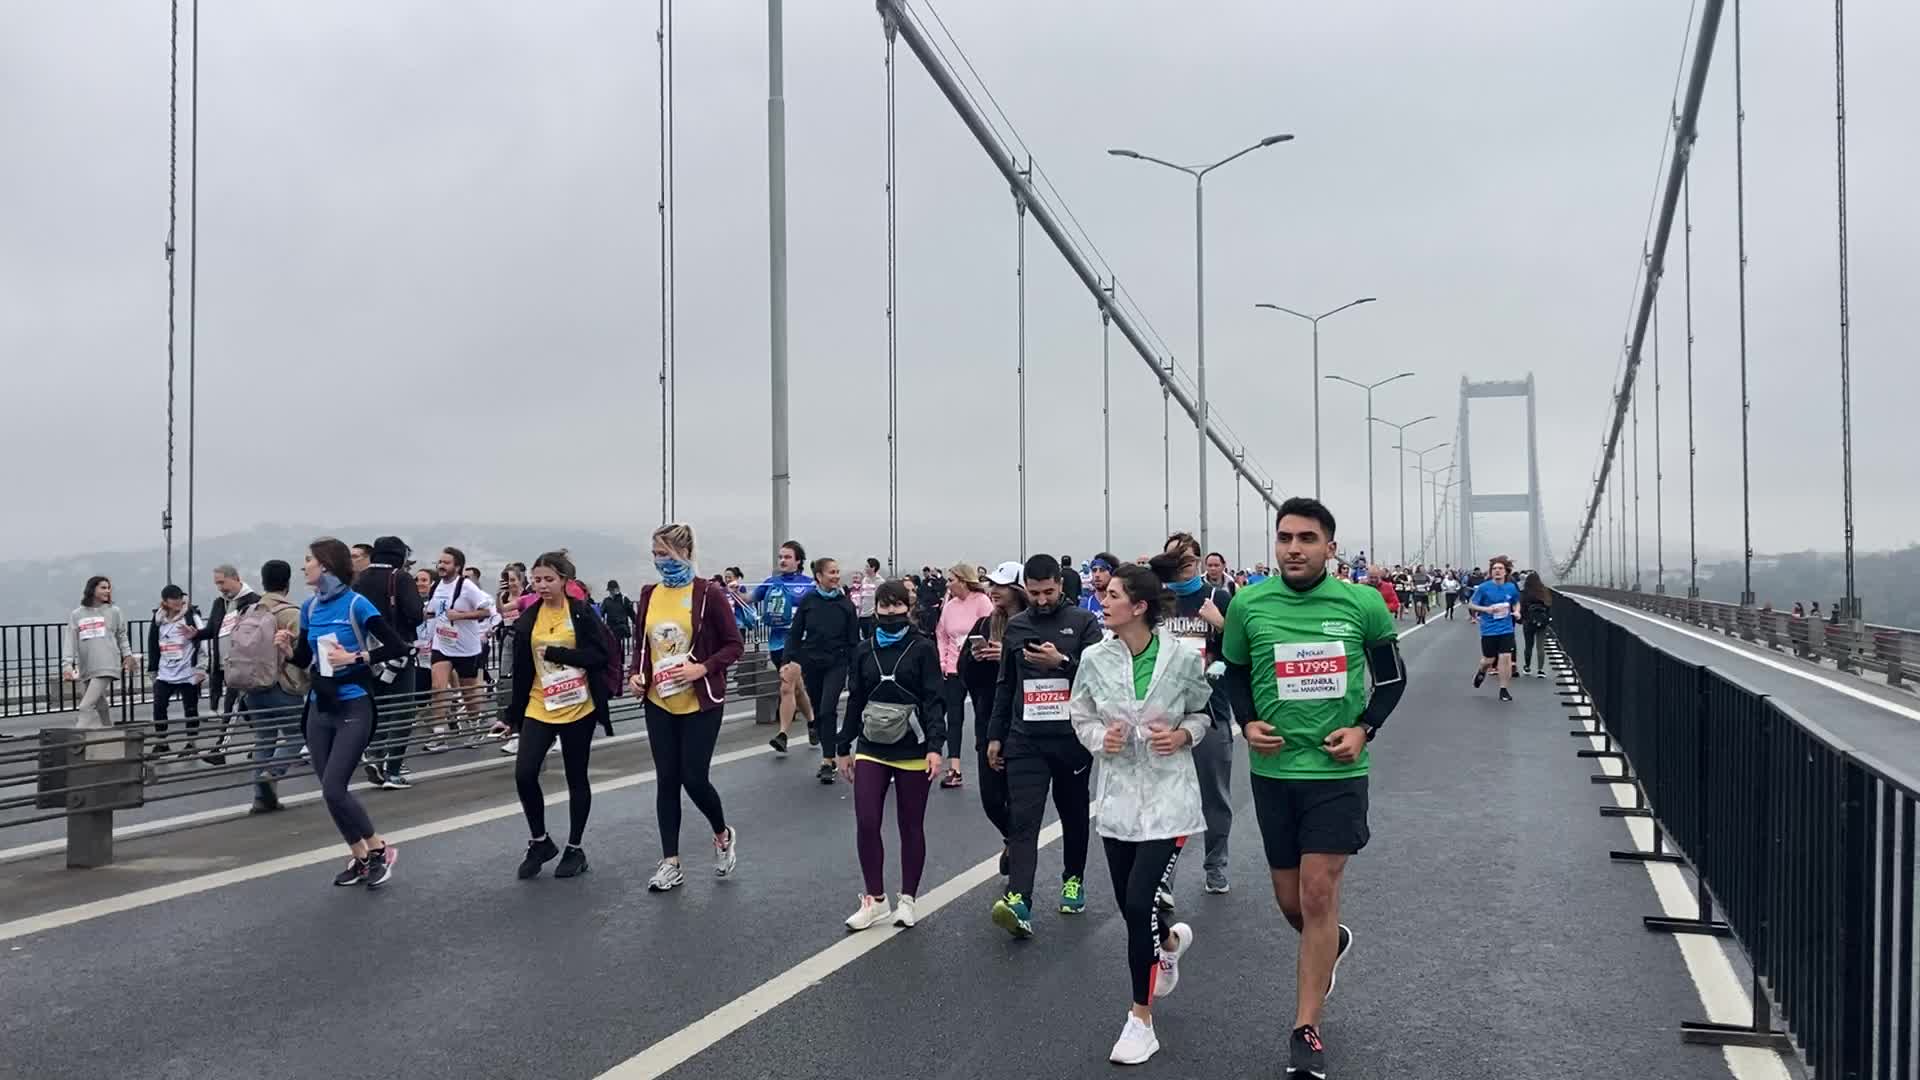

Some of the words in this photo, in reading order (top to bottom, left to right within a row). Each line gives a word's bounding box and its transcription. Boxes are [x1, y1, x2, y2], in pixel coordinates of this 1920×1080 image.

[1285, 662, 1295, 674] E
[1297, 660, 1338, 673] 17995
[1035, 692, 1065, 701] 20724
